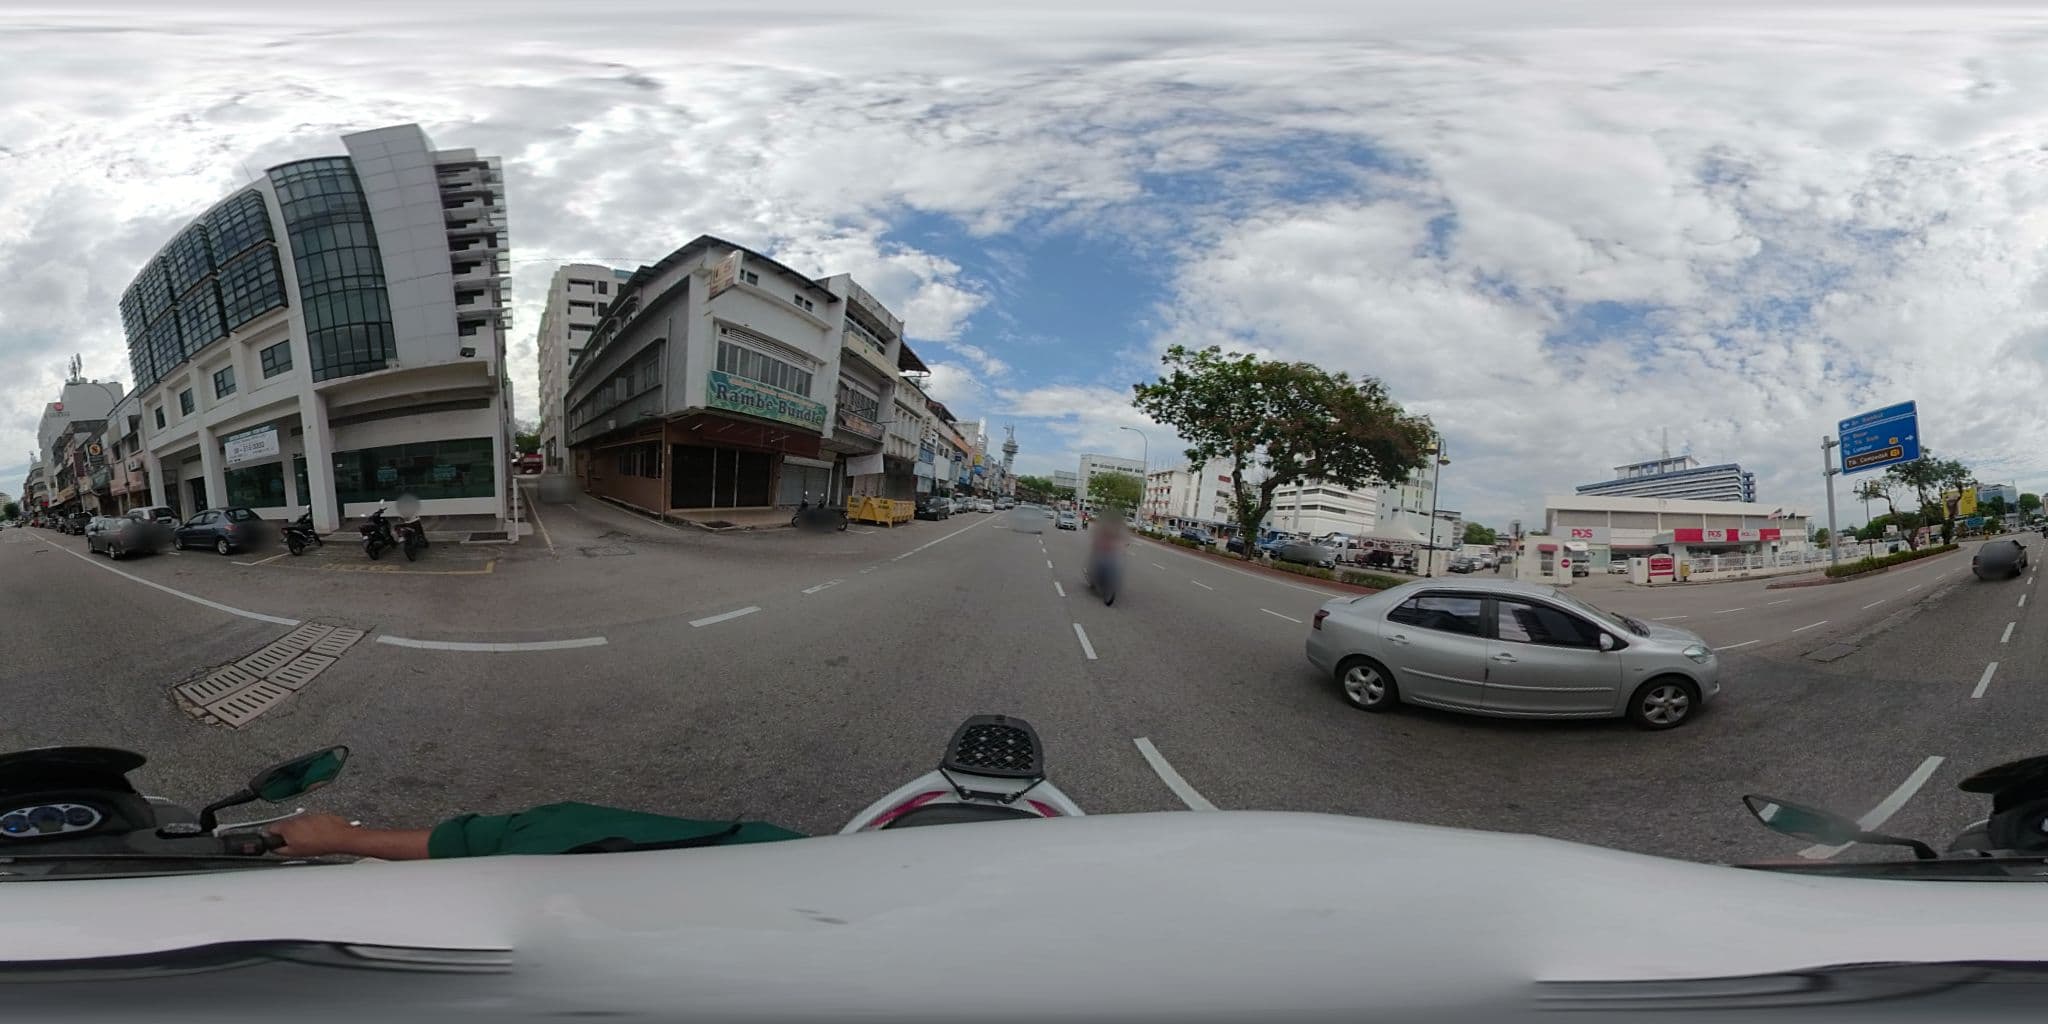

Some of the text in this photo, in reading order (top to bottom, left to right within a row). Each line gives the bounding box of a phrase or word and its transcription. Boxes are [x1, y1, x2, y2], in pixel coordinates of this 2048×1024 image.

[716, 383, 773, 410] Rambe
[778, 401, 823, 425] Bundle
[1571, 528, 1593, 538] POS
